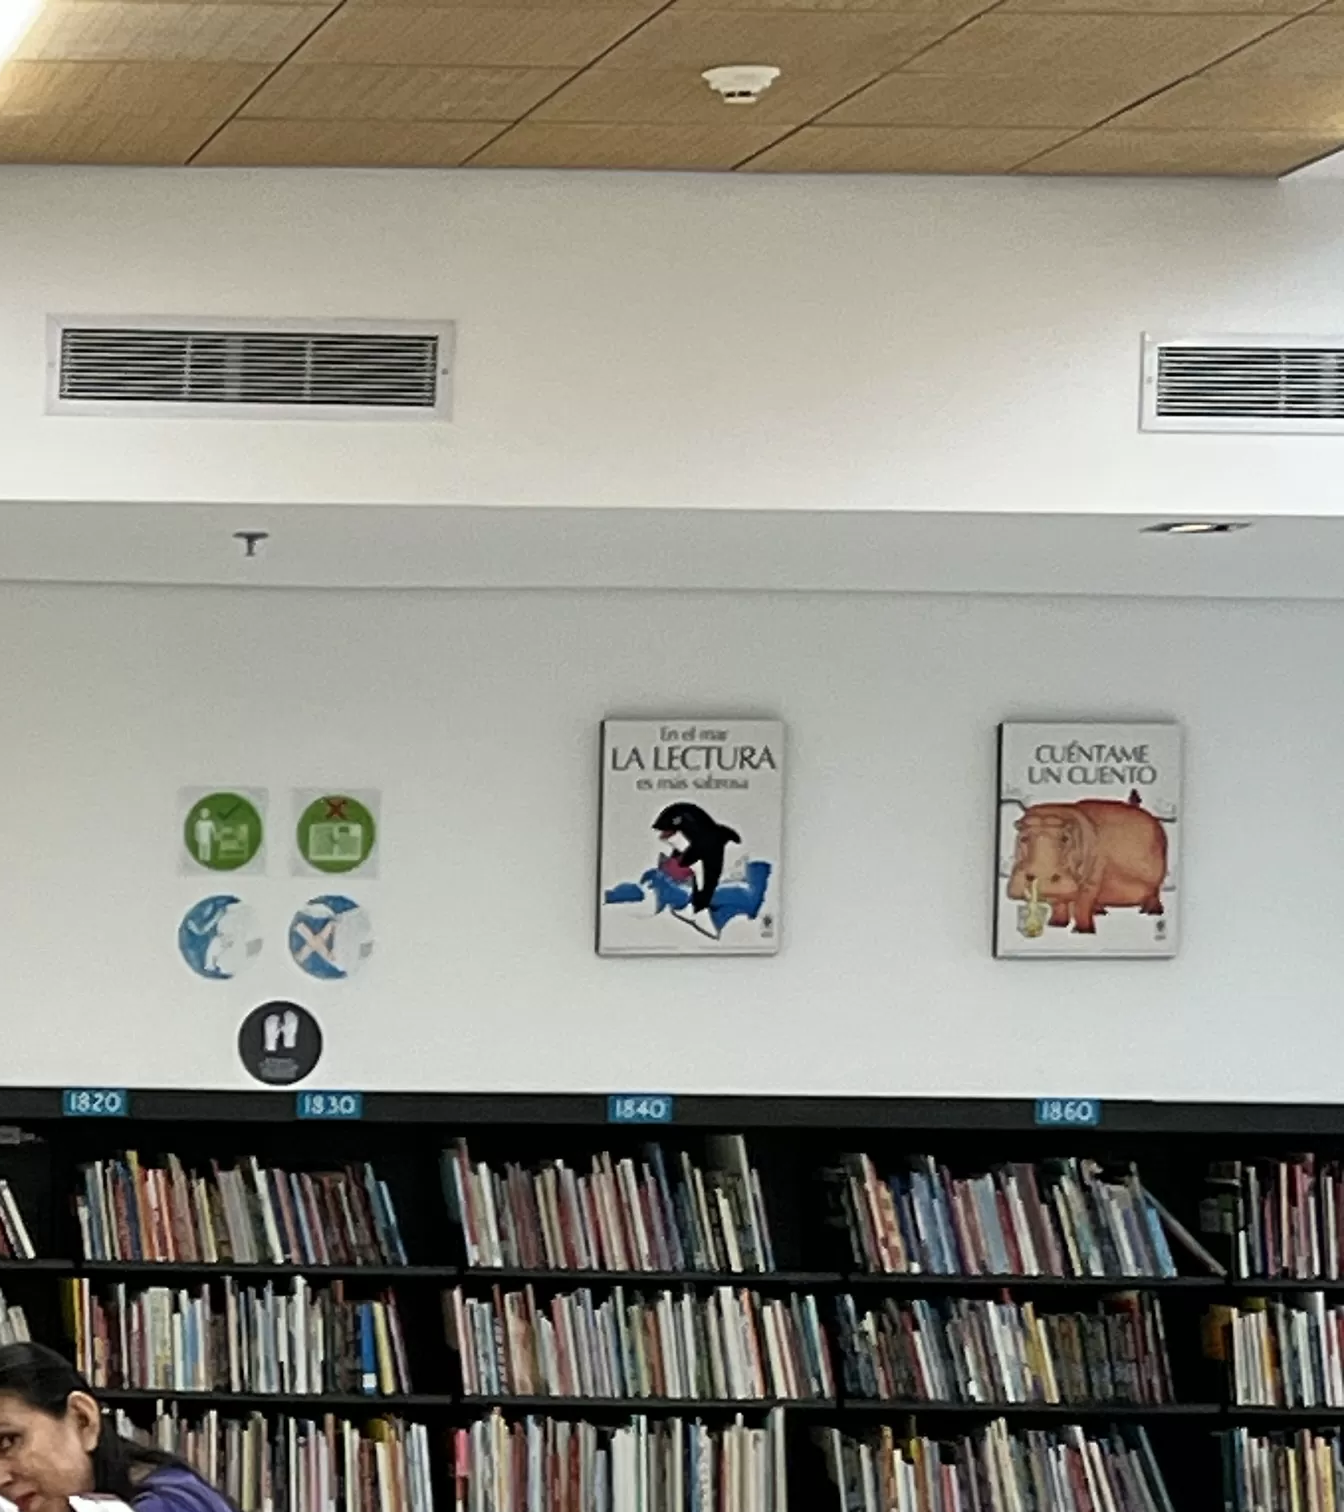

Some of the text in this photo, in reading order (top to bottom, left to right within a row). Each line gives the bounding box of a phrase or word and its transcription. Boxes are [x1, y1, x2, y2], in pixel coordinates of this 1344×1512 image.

[612, 745, 777, 771] LA LECTURA
[1035, 739, 1150, 764] CUÉNTAME
[636, 777, 653, 790] es
[1027, 765, 1157, 786] UN CUENTO
[70, 1091, 122, 1112] 1820
[304, 1095, 356, 1115] 1830
[615, 1099, 666, 1119] 1840
[1042, 1101, 1092, 1121] 1860
